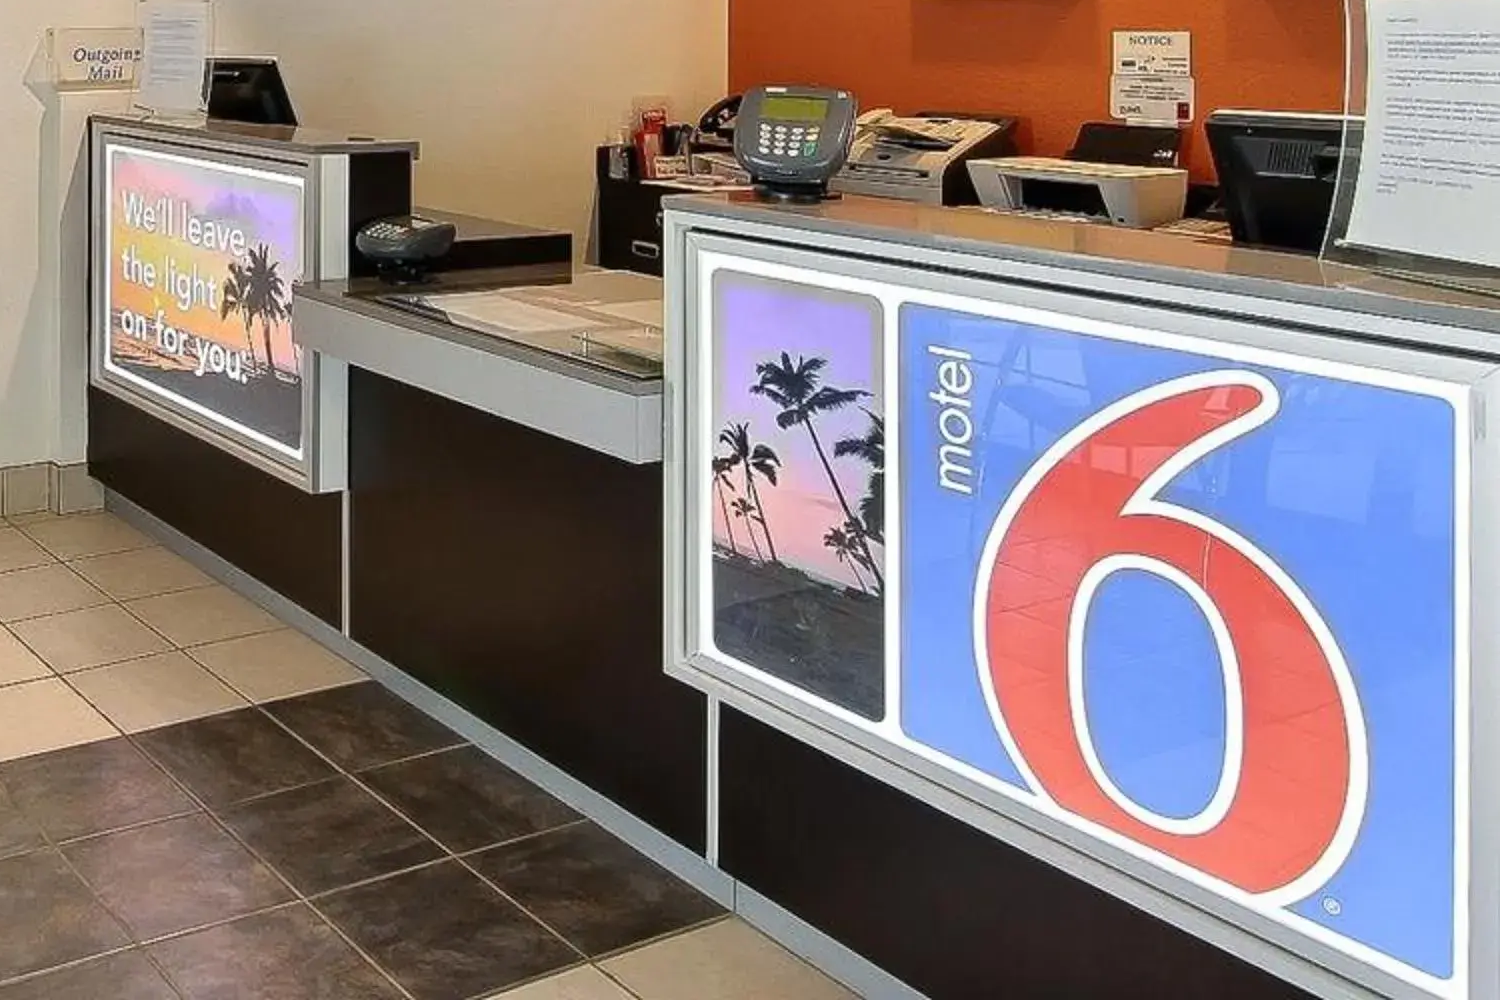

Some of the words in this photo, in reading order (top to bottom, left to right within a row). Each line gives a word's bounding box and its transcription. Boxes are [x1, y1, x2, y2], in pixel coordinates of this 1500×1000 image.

[73, 47, 141, 64] Outgoing
[1129, 35, 1172, 46] NOTICE
[88, 65, 123, 79] Mail
[121, 191, 174, 237] We'll
[182, 202, 245, 256] leave
[121, 245, 156, 288] the
[165, 256, 219, 310] light
[121, 310, 148, 341] on
[151, 311, 189, 353] for
[928, 344, 973, 495] motel
[972, 367, 1371, 908] 6
